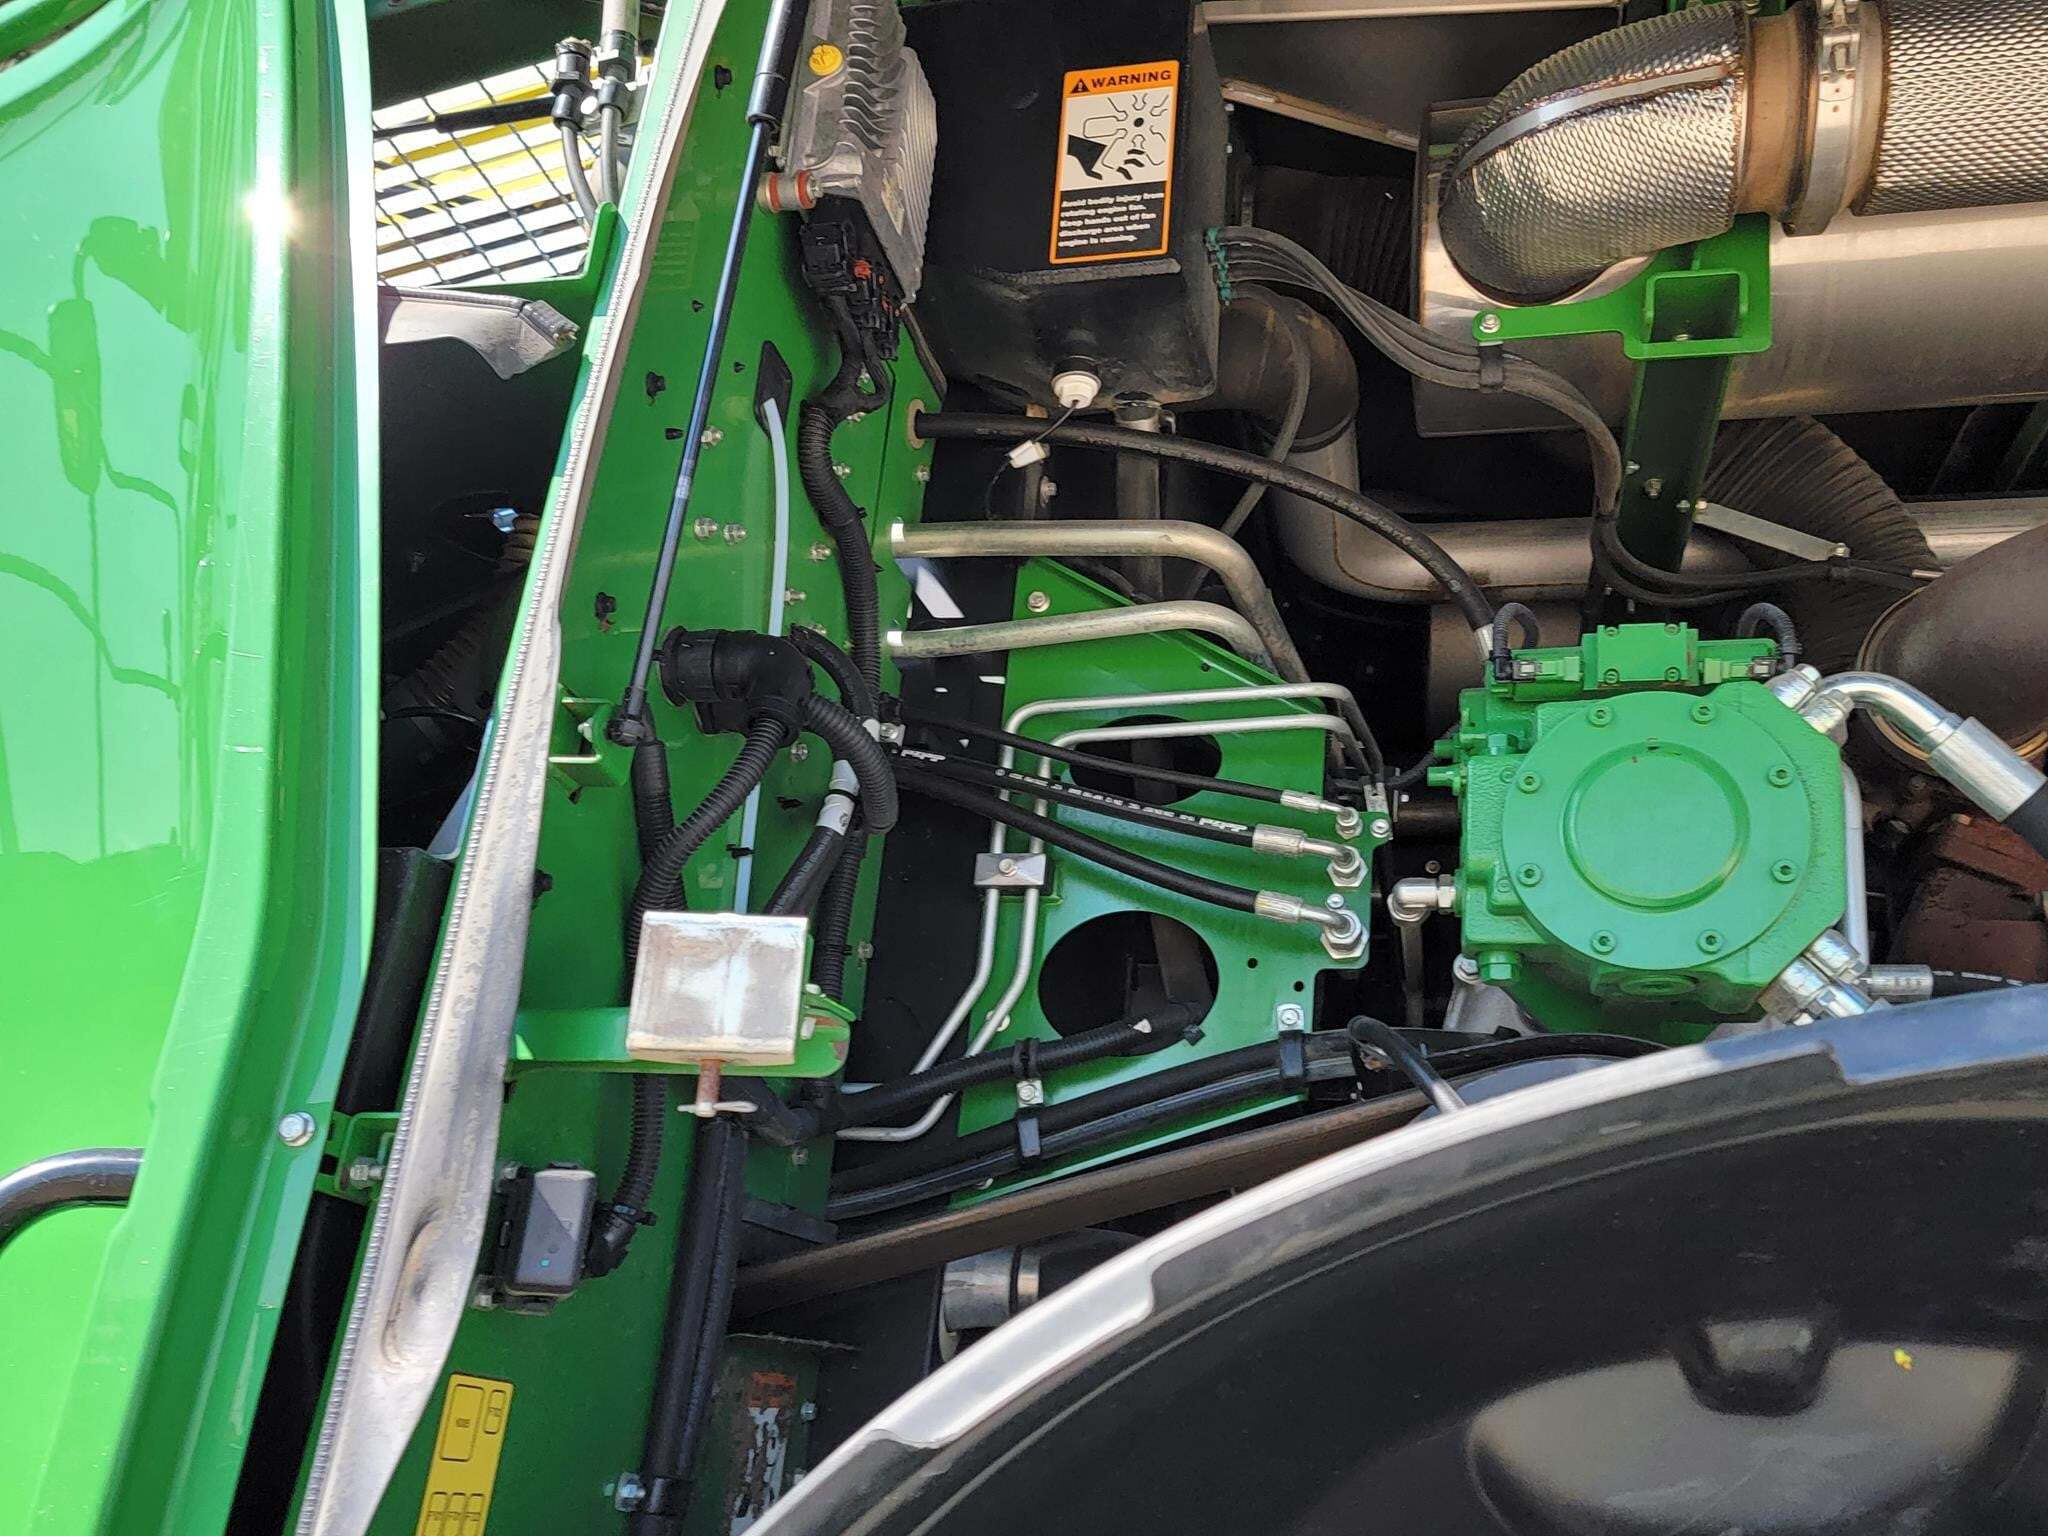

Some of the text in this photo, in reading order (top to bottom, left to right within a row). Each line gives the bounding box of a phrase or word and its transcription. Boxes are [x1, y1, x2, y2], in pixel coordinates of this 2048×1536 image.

[1091, 70, 1172, 88] WARNING
[1061, 192, 1165, 208] Avoid bodily injury from
[1060, 209, 1096, 218] rotating
[1096, 205, 1128, 215] engine
[1059, 212, 1157, 228] Keep hands out of fan
[1058, 223, 1151, 238] discharge area when
[1057, 238, 1089, 247] engine
[1099, 234, 1138, 243] running.
